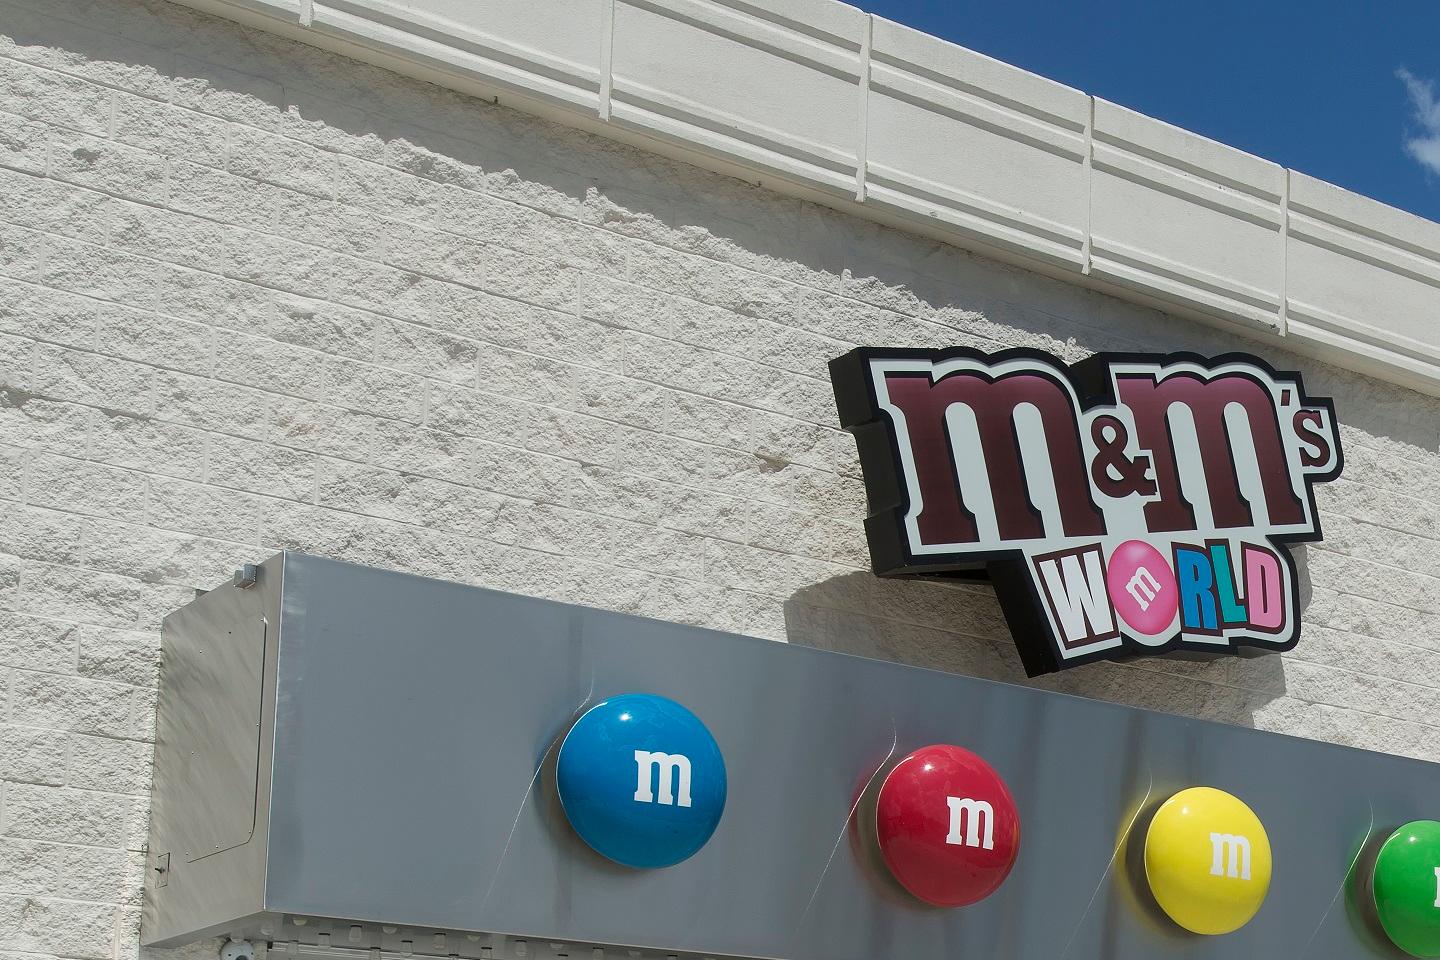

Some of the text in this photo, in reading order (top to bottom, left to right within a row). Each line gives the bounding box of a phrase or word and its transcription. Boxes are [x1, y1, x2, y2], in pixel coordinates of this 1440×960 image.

[634, 749, 691, 808] m
[946, 795, 994, 850] m
[1209, 832, 1252, 881] m
